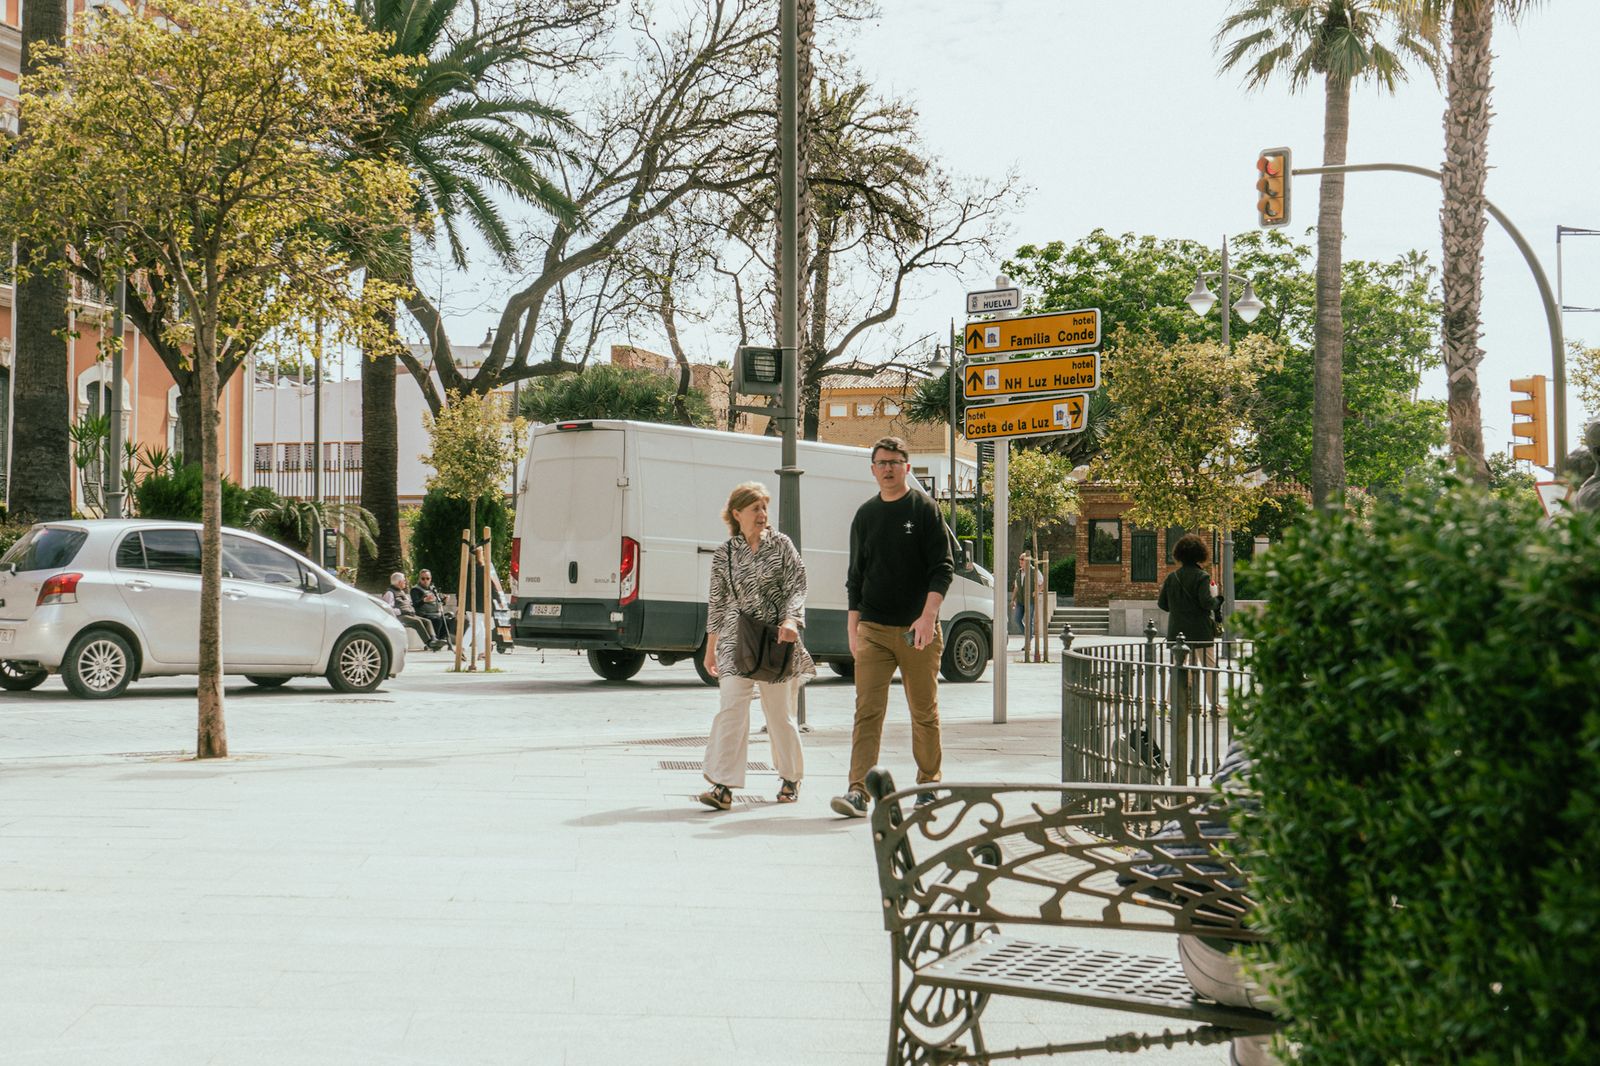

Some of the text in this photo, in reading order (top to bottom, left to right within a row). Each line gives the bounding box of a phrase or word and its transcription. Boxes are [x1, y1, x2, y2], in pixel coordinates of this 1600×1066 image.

[983, 299, 1012, 309] HUELVA
[1073, 316, 1094, 326] hotel
[1010, 329, 1094, 347] Familia Conde
[1072, 360, 1093, 369] hotel
[1005, 373, 1093, 389] NH Luz Huelva
[967, 412, 986, 420] hotel
[967, 417, 1049, 435] Costa de la Luz
